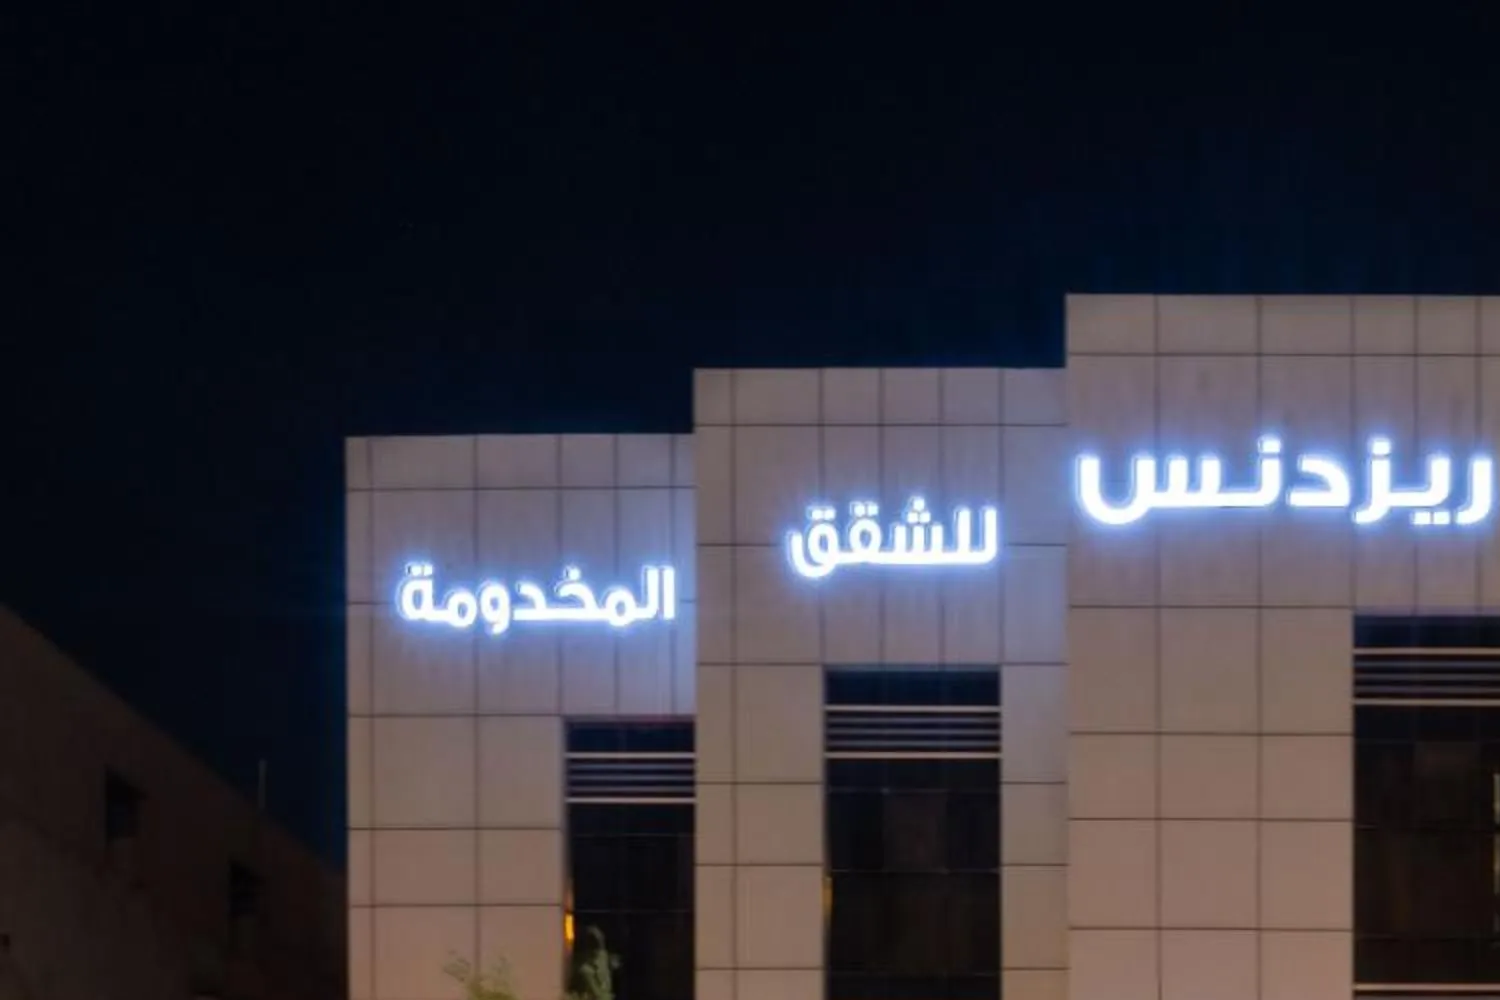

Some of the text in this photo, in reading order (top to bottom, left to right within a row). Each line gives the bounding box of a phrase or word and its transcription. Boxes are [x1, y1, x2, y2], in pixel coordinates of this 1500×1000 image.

[1079, 436, 1493, 525] ريزدنس
[788, 497, 999, 579] للشقق
[399, 563, 676, 635] المخدومة
